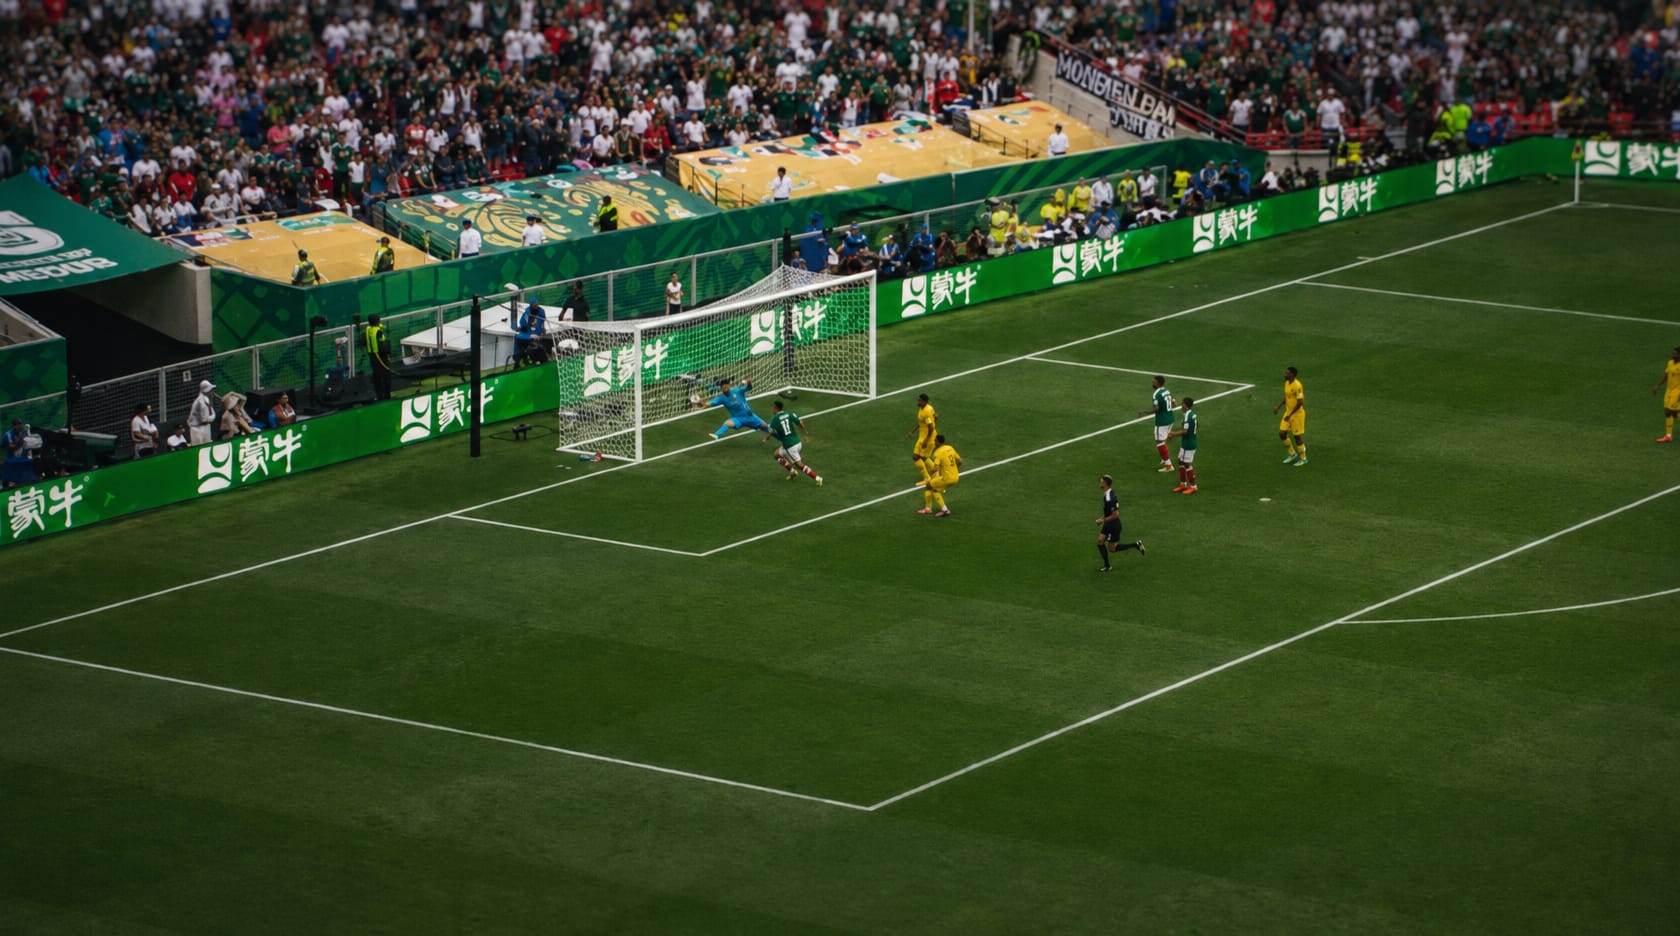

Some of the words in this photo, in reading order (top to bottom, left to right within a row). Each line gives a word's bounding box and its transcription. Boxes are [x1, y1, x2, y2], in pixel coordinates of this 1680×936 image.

[1458, 151, 1493, 189] 蒙牛
[1341, 180, 1378, 216] 蒙牛
[1217, 205, 1258, 245] 蒙牛
[1080, 235, 1125, 277] 蒙牛
[930, 266, 977, 311] 蒙牛
[239, 428, 303, 482] 蒙牛
[7, 479, 83, 539] 蒙牛
